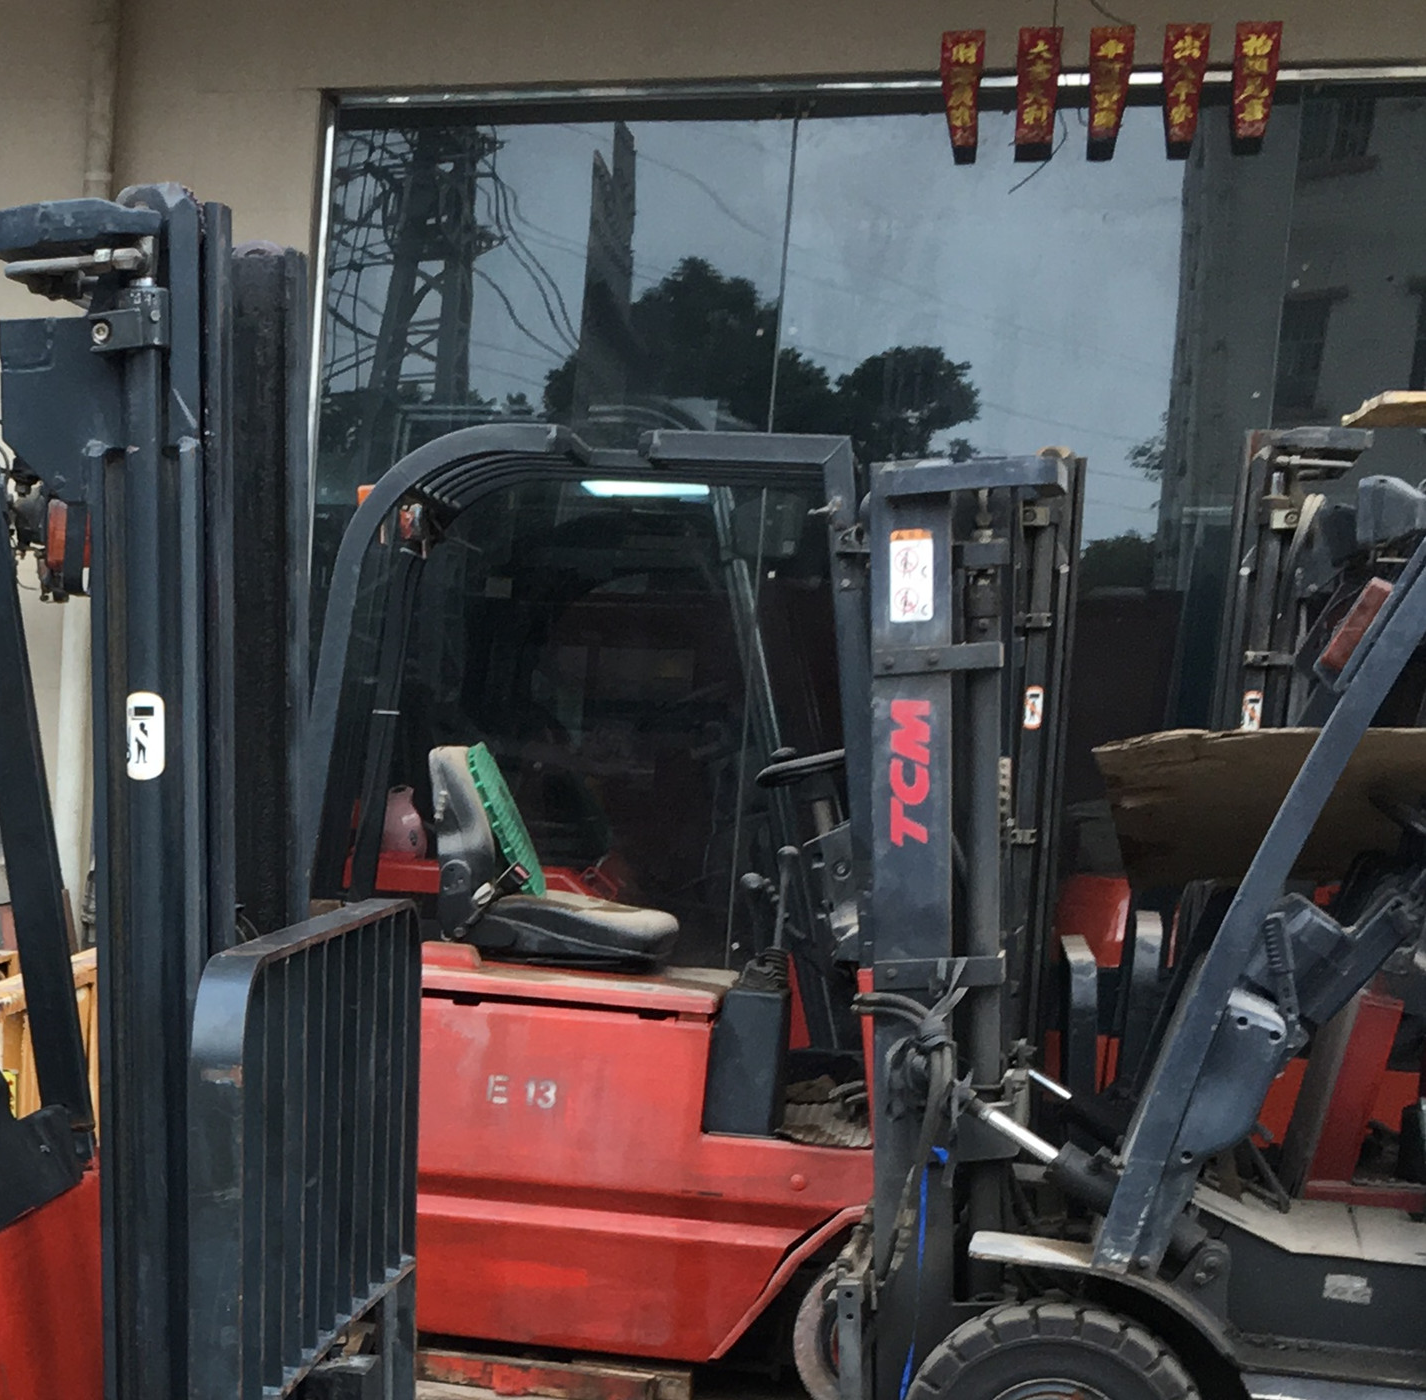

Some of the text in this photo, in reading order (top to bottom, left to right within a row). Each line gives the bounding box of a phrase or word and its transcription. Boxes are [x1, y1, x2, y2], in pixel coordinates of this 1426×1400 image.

[890, 700, 931, 847] TCM
[486, 1074, 558, 1110] E 13
